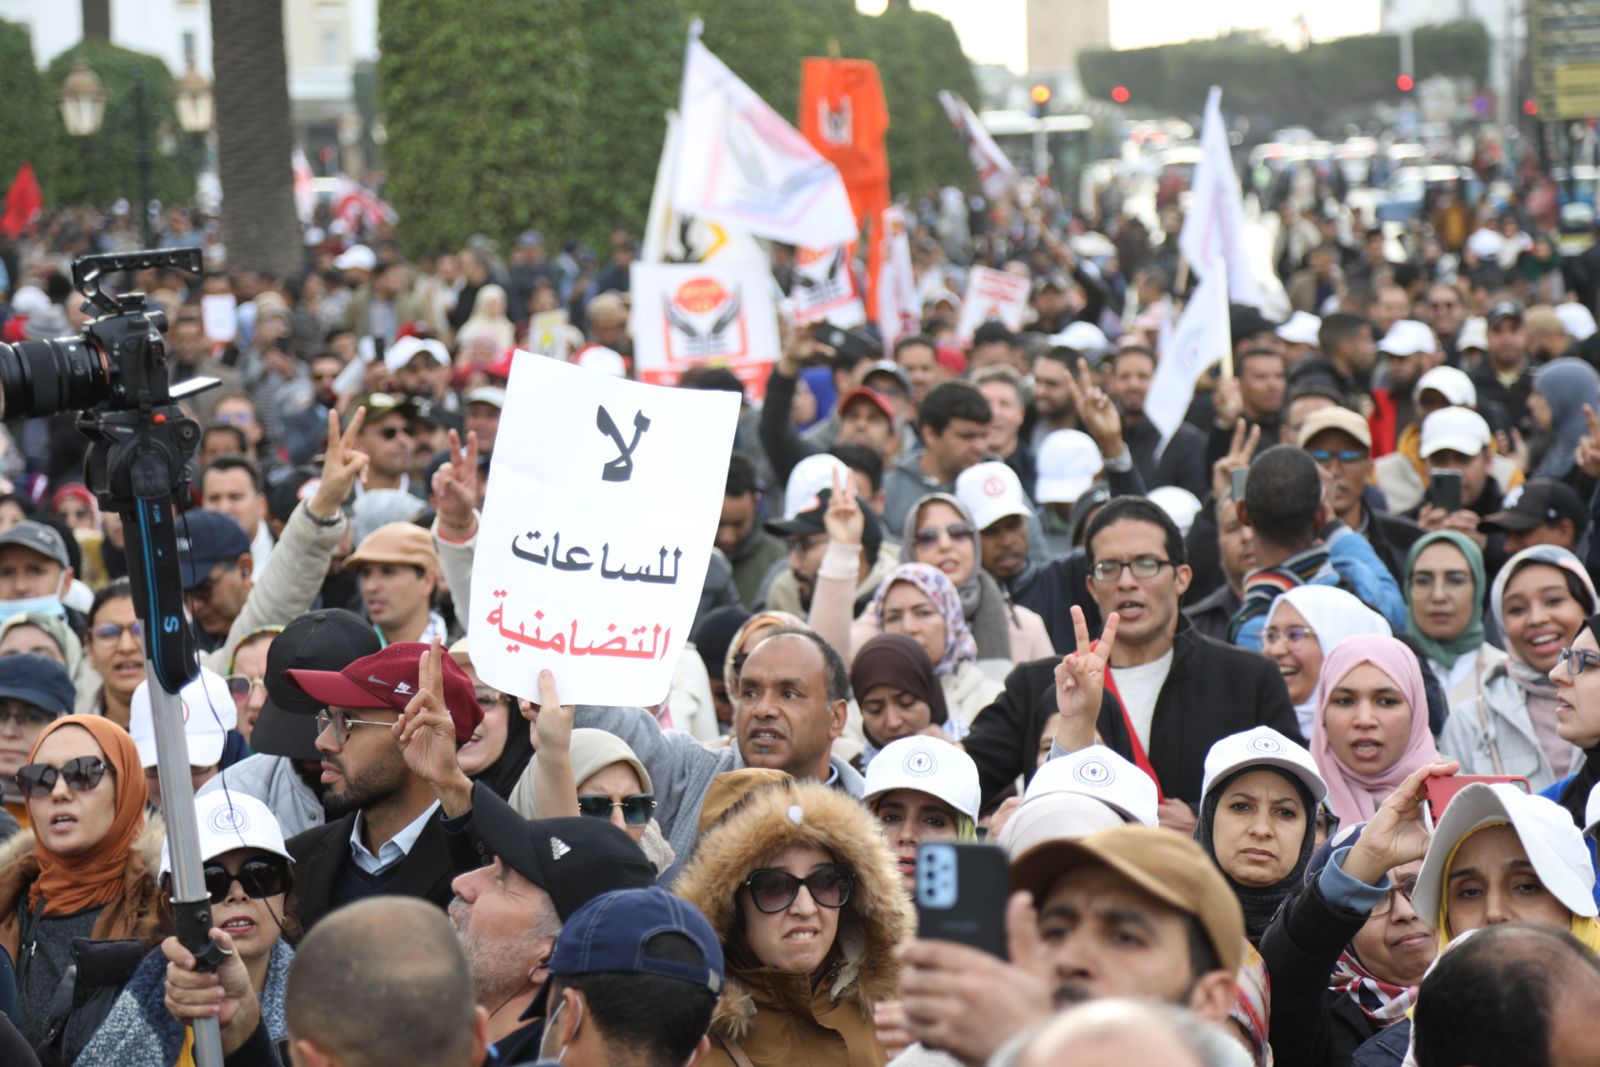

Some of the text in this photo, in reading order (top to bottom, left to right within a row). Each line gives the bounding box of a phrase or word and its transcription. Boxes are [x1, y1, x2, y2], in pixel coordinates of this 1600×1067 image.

[596, 404, 651, 482] لا
[511, 530, 683, 585] للساعات
[486, 589, 671, 660] التضامنية
